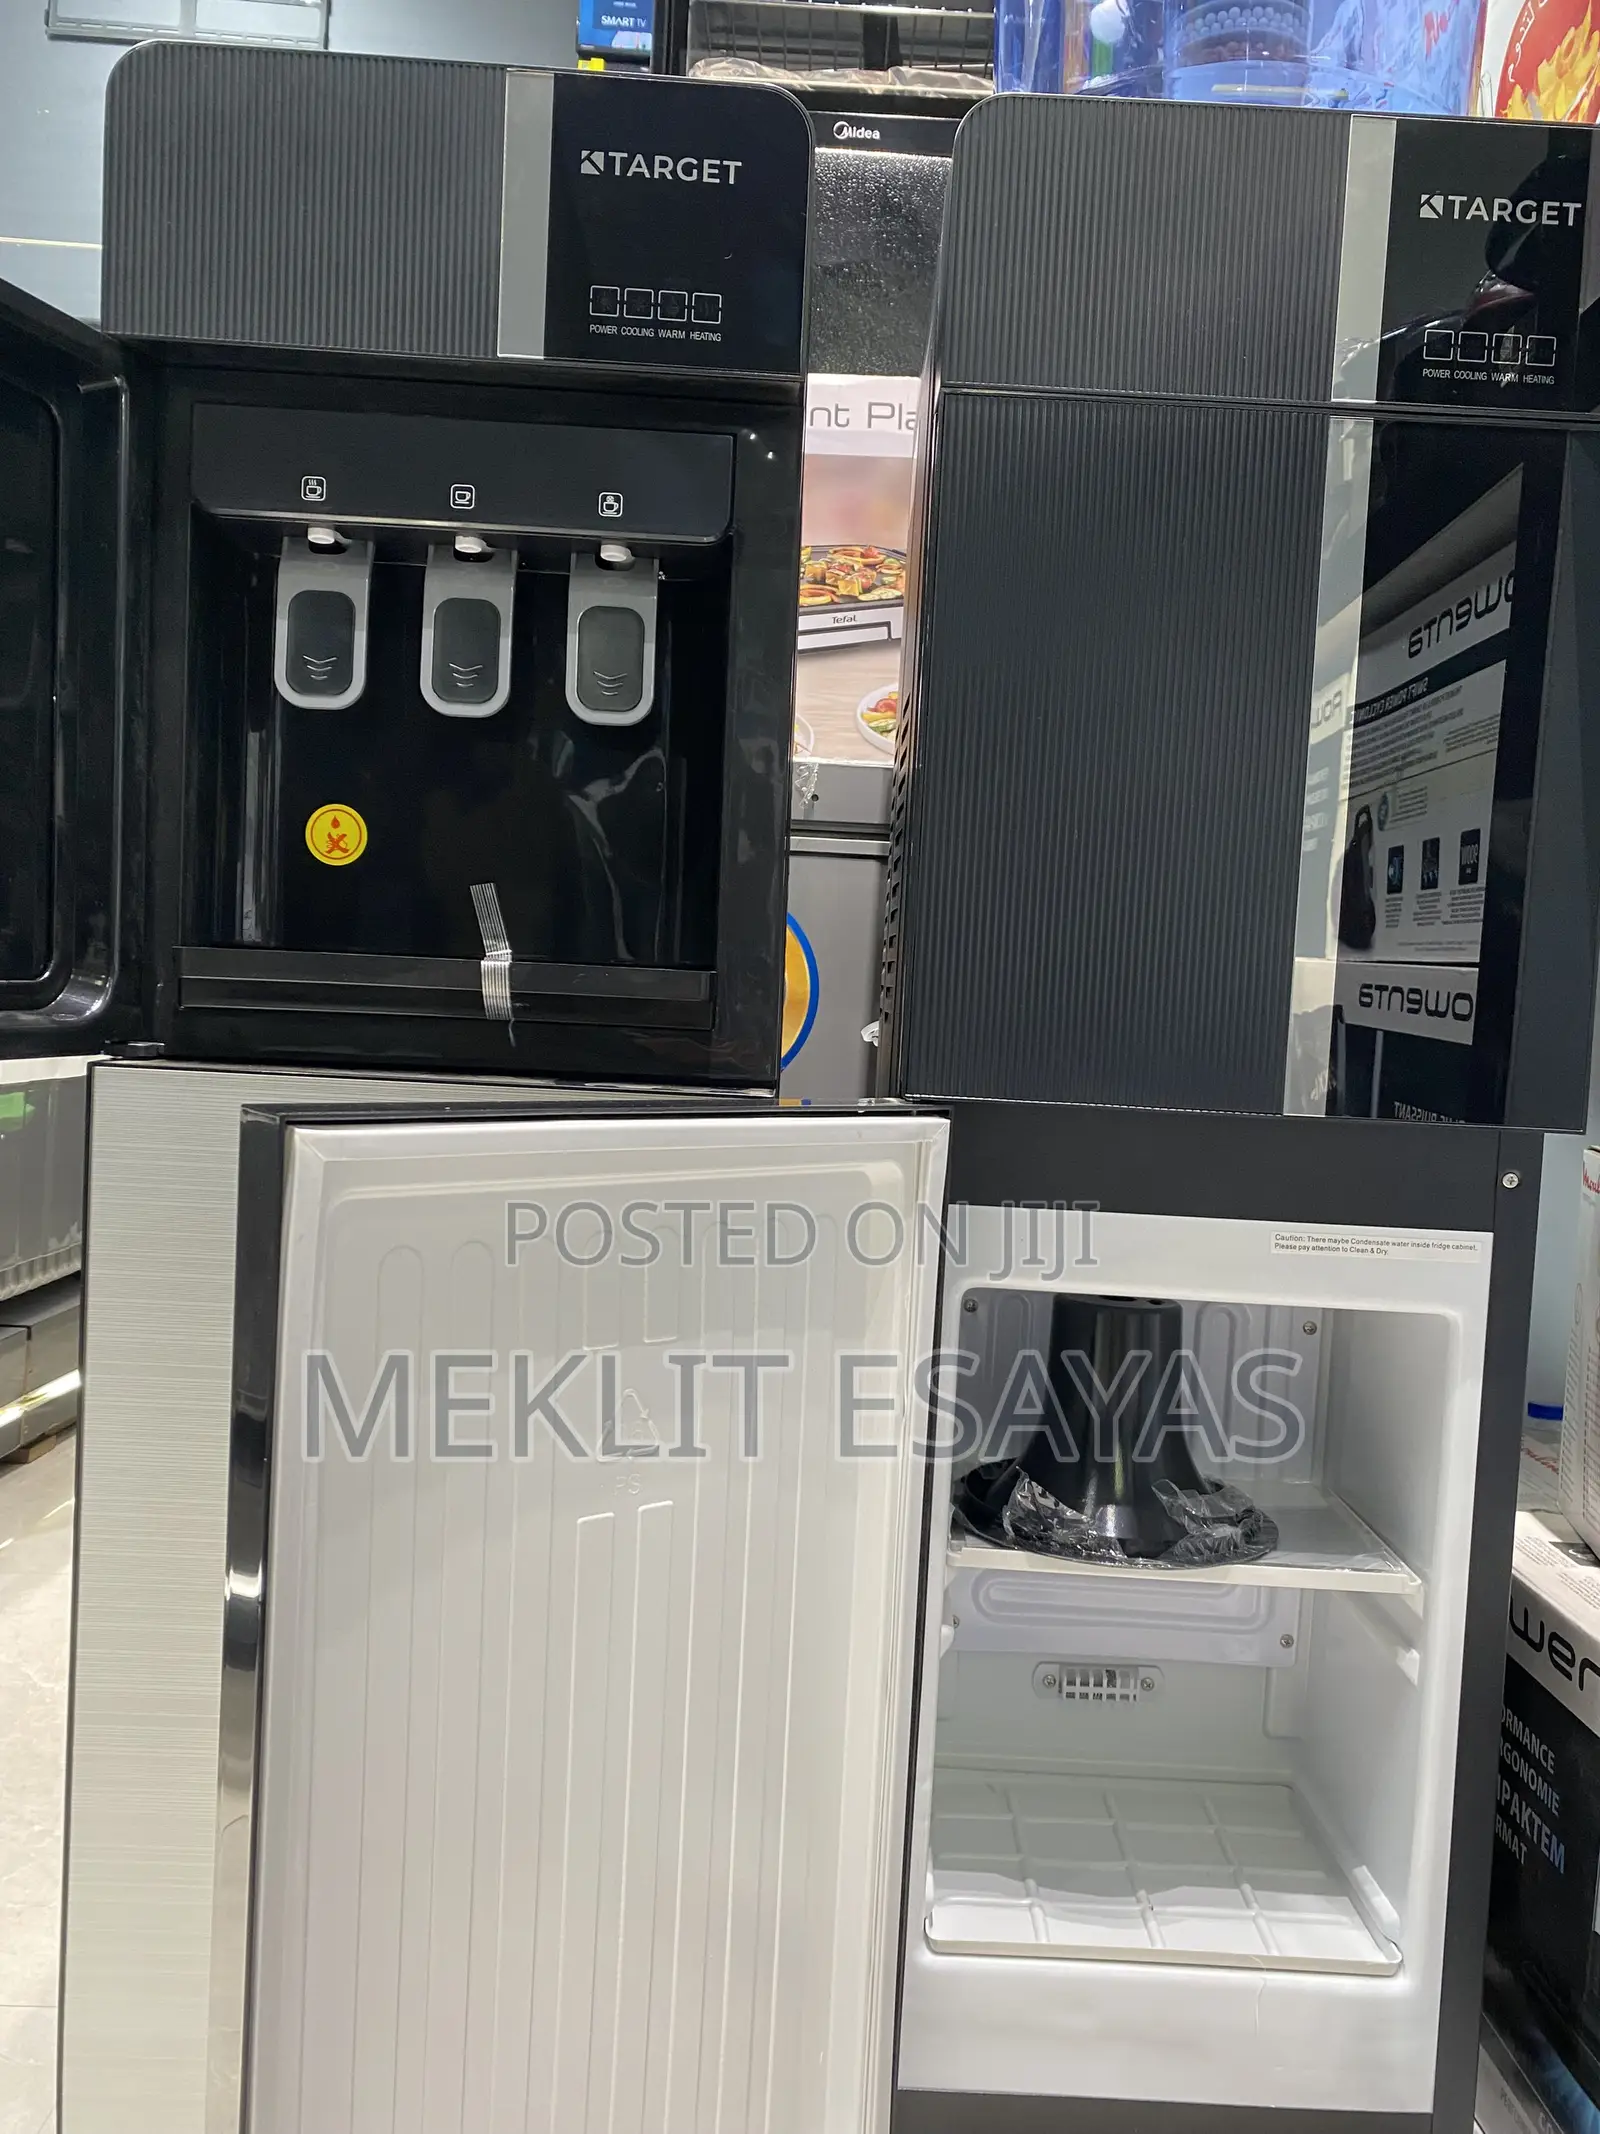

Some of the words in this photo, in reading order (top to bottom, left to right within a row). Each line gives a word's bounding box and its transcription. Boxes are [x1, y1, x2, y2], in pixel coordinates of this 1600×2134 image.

[601, 15, 635, 27] SMART
[637, 18, 647, 27] TV
[833, 121, 880, 139] Midea
[608, 151, 743, 185] TARGET
[1448, 195, 1582, 226] TARGET
[589, 324, 618, 335] POWER
[621, 326, 654, 338] COOLING
[657, 328, 686, 339] WARM
[689, 331, 721, 342] HEATING
[1422, 368, 1450, 379] POWER
[1453, 370, 1487, 381] COOLING
[1491, 372, 1519, 384] WARM
[1523, 375, 1555, 385] HEATING
[832, 614, 856, 624] Tefal
[1275, 1234, 1305, 1242] Caution:
[1350, 1238, 1390, 1246] Condensate
[1431, 1242, 1450, 1250] fridge
